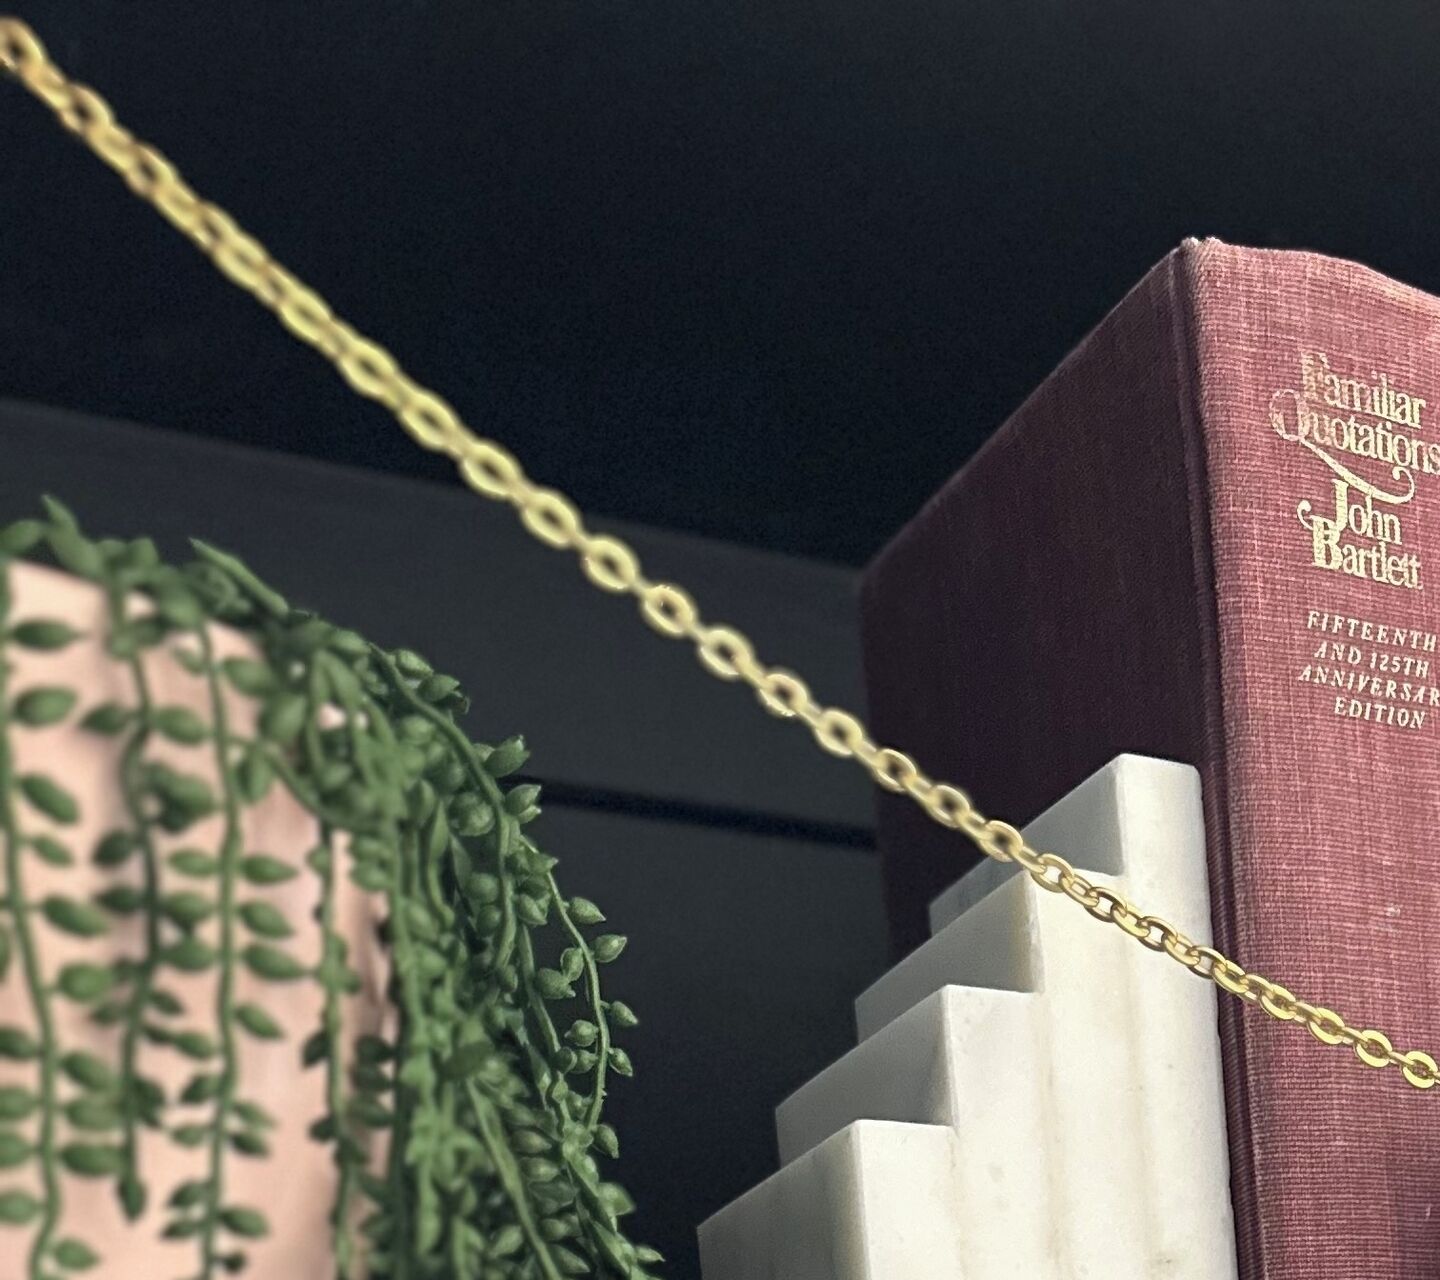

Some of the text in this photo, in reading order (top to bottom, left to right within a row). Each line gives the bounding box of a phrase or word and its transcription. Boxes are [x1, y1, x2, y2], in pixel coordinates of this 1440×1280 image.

[1300, 352, 1426, 429] Familiar
[1297, 479, 1403, 544] John
[1312, 515, 1424, 589] Bartlett
[1307, 611, 1438, 652] FIFTEENTH
[1314, 641, 1430, 678] AND 125TH
[1334, 696, 1426, 730] EDITION
